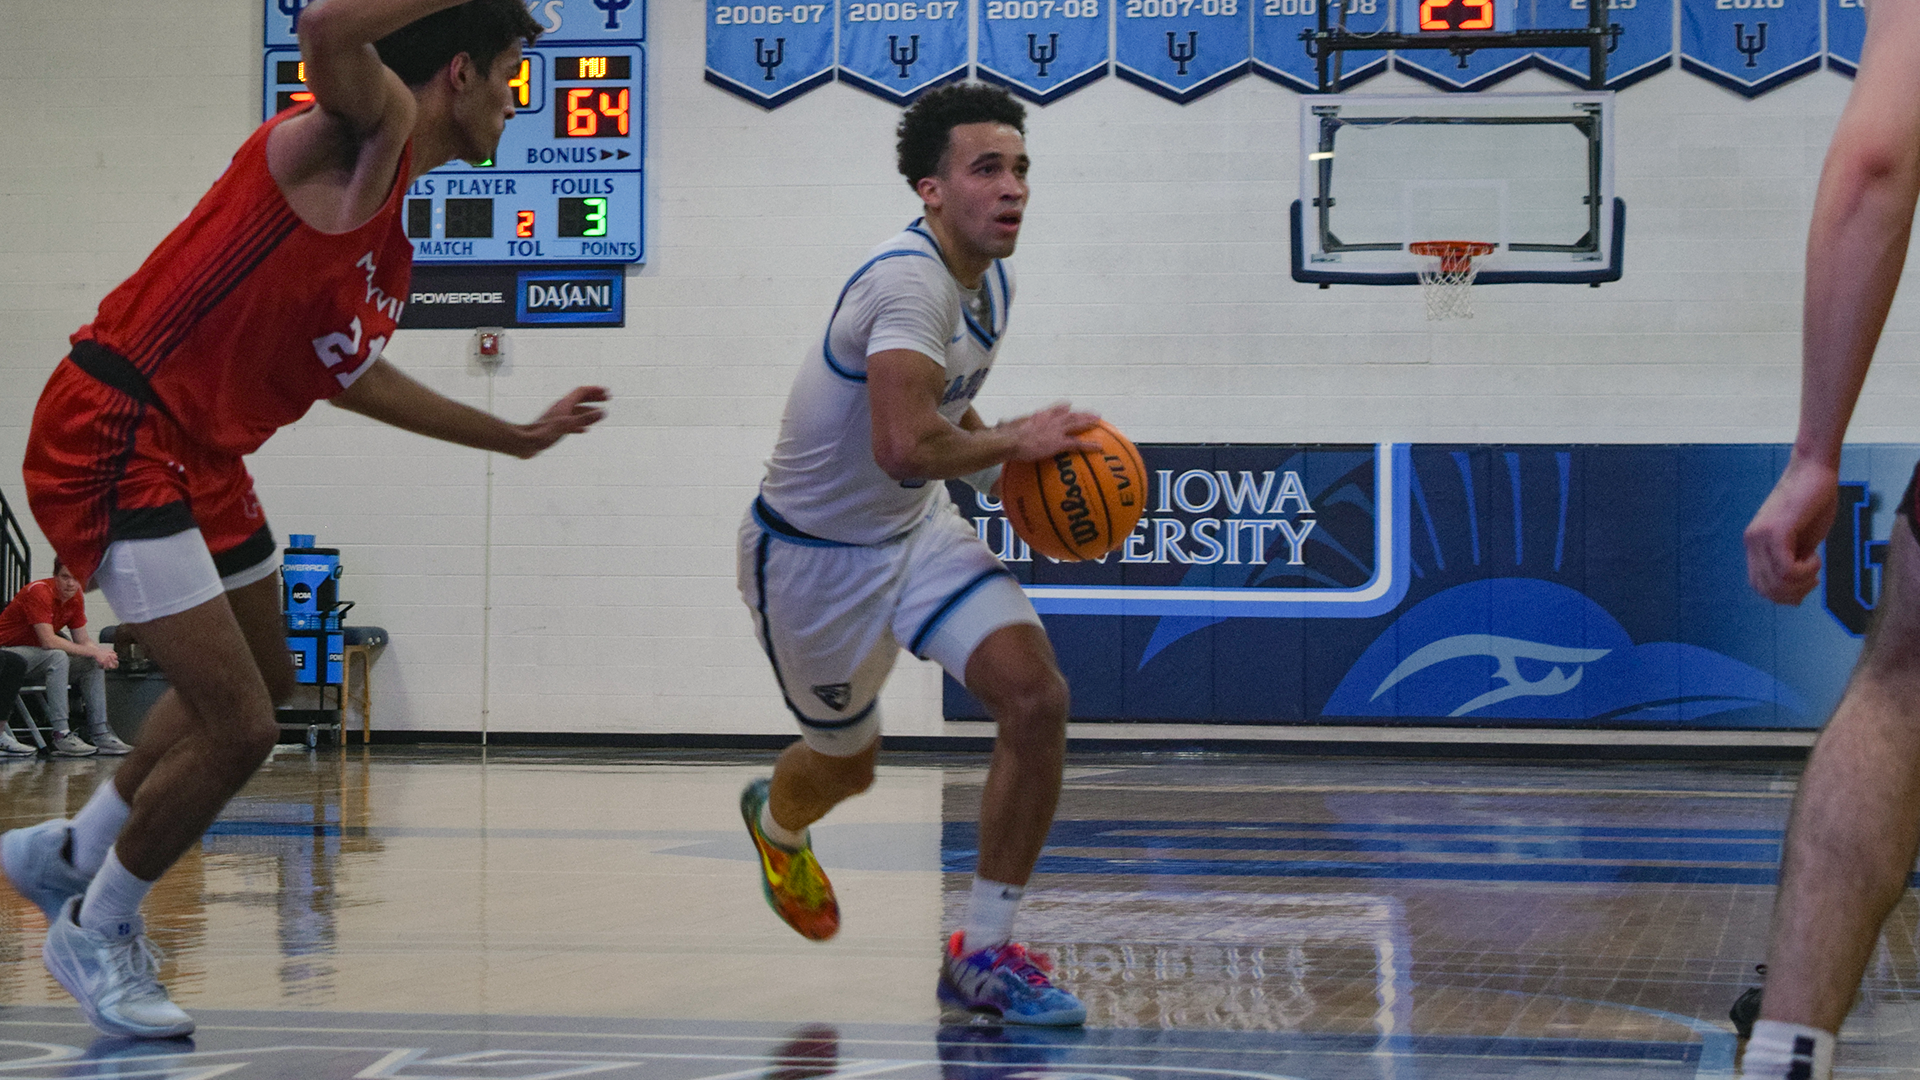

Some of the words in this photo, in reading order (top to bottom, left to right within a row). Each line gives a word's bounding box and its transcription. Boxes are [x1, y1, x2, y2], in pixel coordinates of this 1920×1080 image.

[716, 5, 826, 25] 2006-07
[850, 1, 959, 22] 2006-07
[987, 0, 1099, 20] 2007-08
[1126, 0, 1238, 18] 2007-08
[579, 57, 607, 78] MU
[567, 88, 629, 137] 64
[527, 148, 597, 164] BONUS
[447, 179, 517, 195] PLAYER
[552, 178, 614, 195] FOULS
[516, 211, 535, 237] 2
[583, 198, 608, 237] 3
[419, 241, 473, 255] MATCH
[508, 241, 545, 257] TOL
[581, 242, 637, 256] POINTS
[410, 292, 504, 304] POWERADE
[528, 282, 610, 310] DASANI
[1054, 451, 1099, 546] Wilson
[1154, 469, 1316, 515] IOWA
[972, 516, 1317, 566] UERSITY
